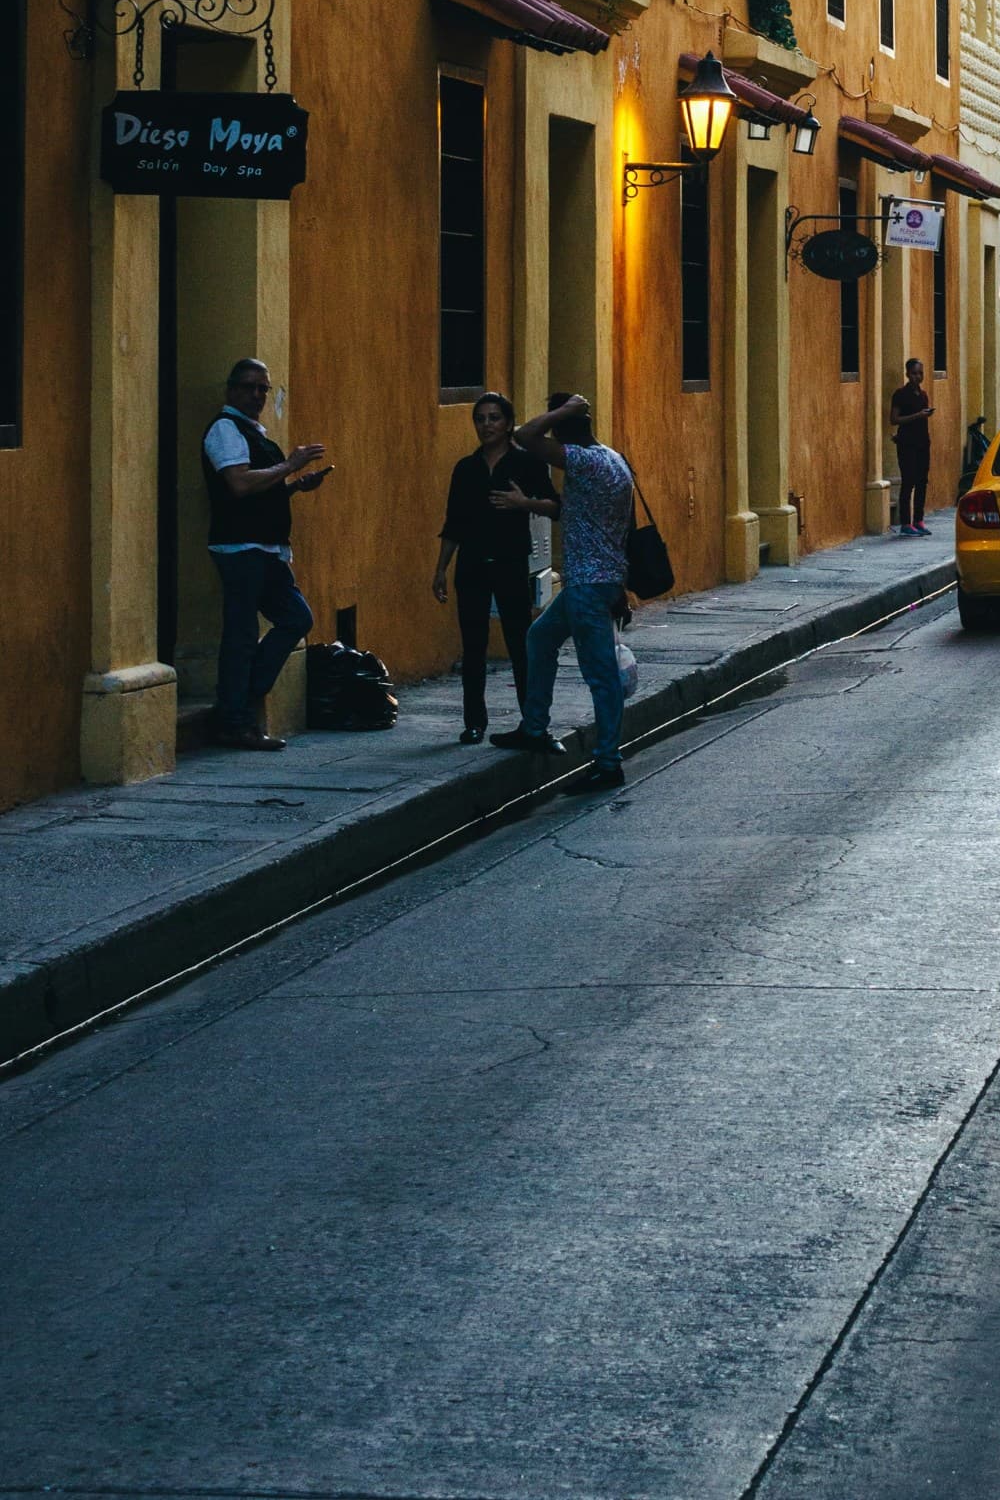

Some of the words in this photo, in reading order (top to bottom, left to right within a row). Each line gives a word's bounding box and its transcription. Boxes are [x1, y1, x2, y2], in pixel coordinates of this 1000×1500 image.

[114, 112, 190, 151] Diego
[203, 162, 228, 176] Day
[237, 165, 262, 176] Spa
